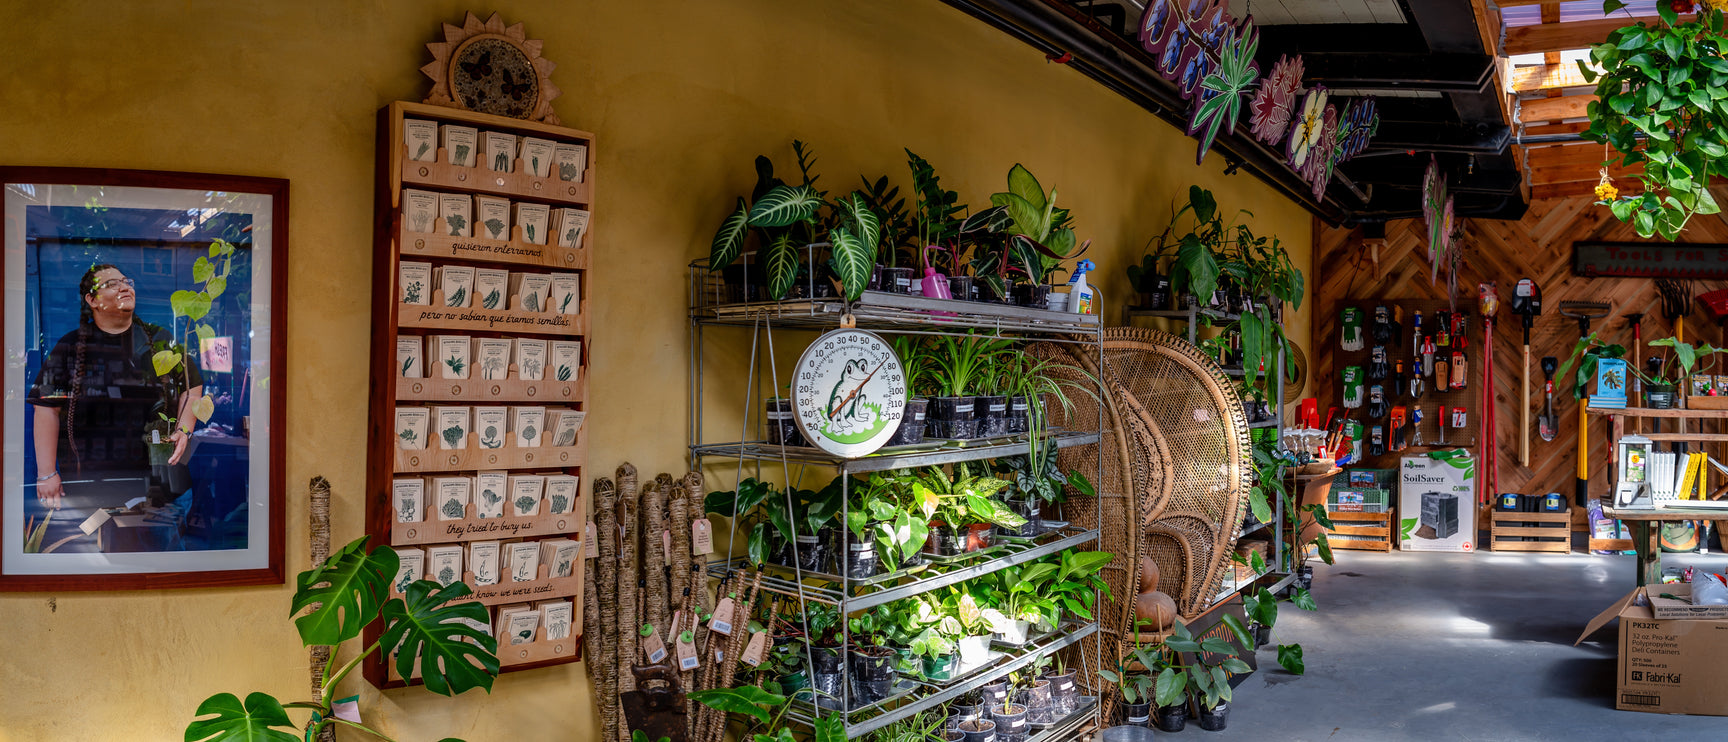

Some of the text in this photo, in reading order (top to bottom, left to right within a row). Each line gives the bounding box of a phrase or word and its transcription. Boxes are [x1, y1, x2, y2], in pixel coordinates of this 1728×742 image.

[452, 243, 544, 257] quisieron enterrarnos.
[1675, 250, 1704, 261] FOR
[419, 312, 441, 321] pero
[490, 316, 504, 327] que
[537, 316, 571, 327] semillas.
[837, 336, 846, 344] 30
[815, 350, 824, 358] 10
[1404, 474, 1445, 483] SoilSaver
[447, 524, 464, 538] they
[467, 523, 487, 533] tried
[490, 522, 499, 531] to
[500, 522, 520, 535] bury
[476, 590, 497, 599] know
[1632, 640, 1678, 648] Polypropylene
